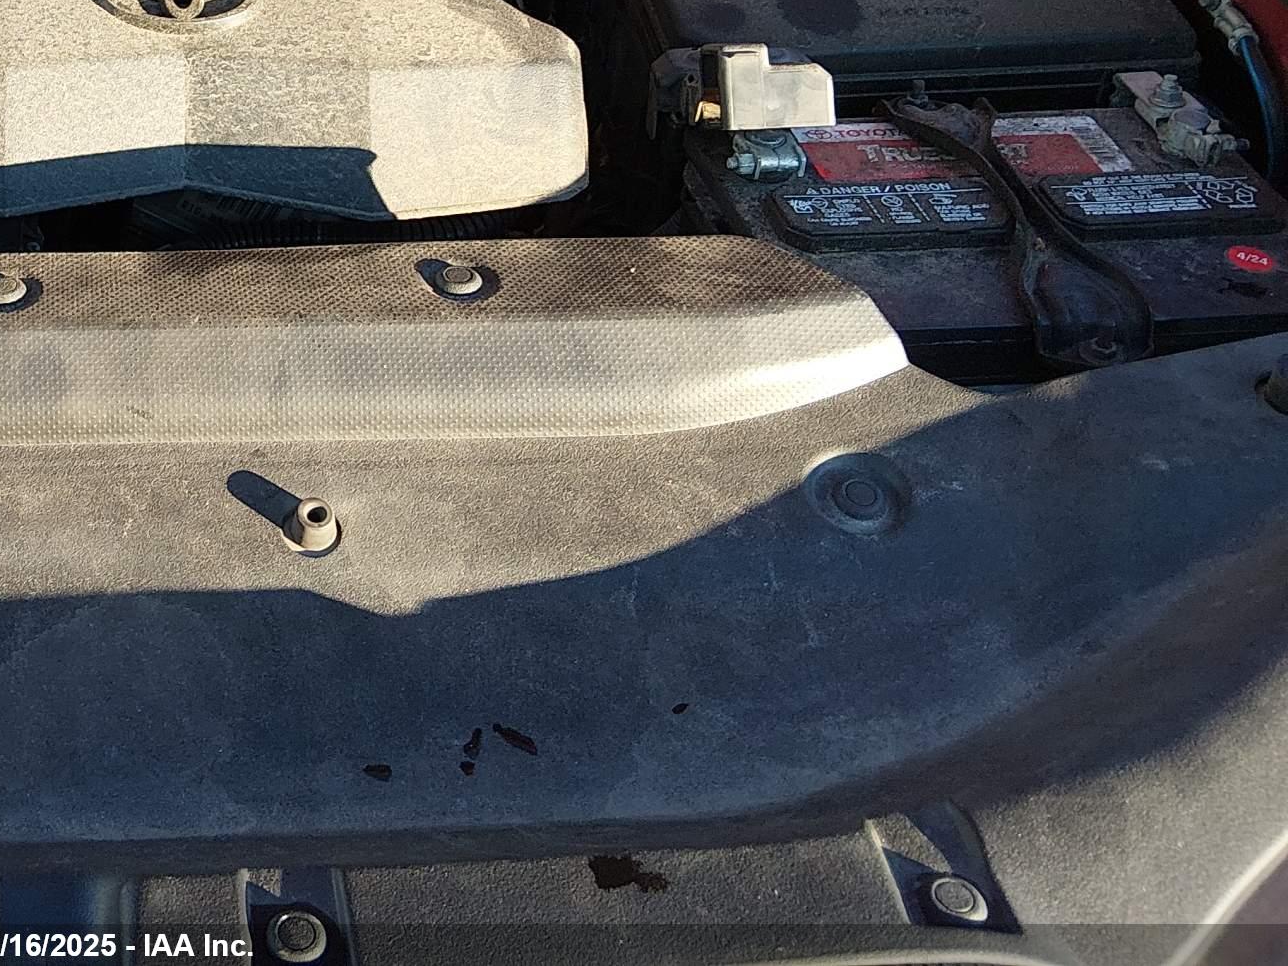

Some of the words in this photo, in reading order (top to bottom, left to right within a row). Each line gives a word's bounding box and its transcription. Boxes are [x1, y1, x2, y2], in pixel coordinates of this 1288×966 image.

[819, 186, 881, 195] DANGER
[894, 182, 952, 192] POISON
[1236, 252, 1269, 266] 4/24
